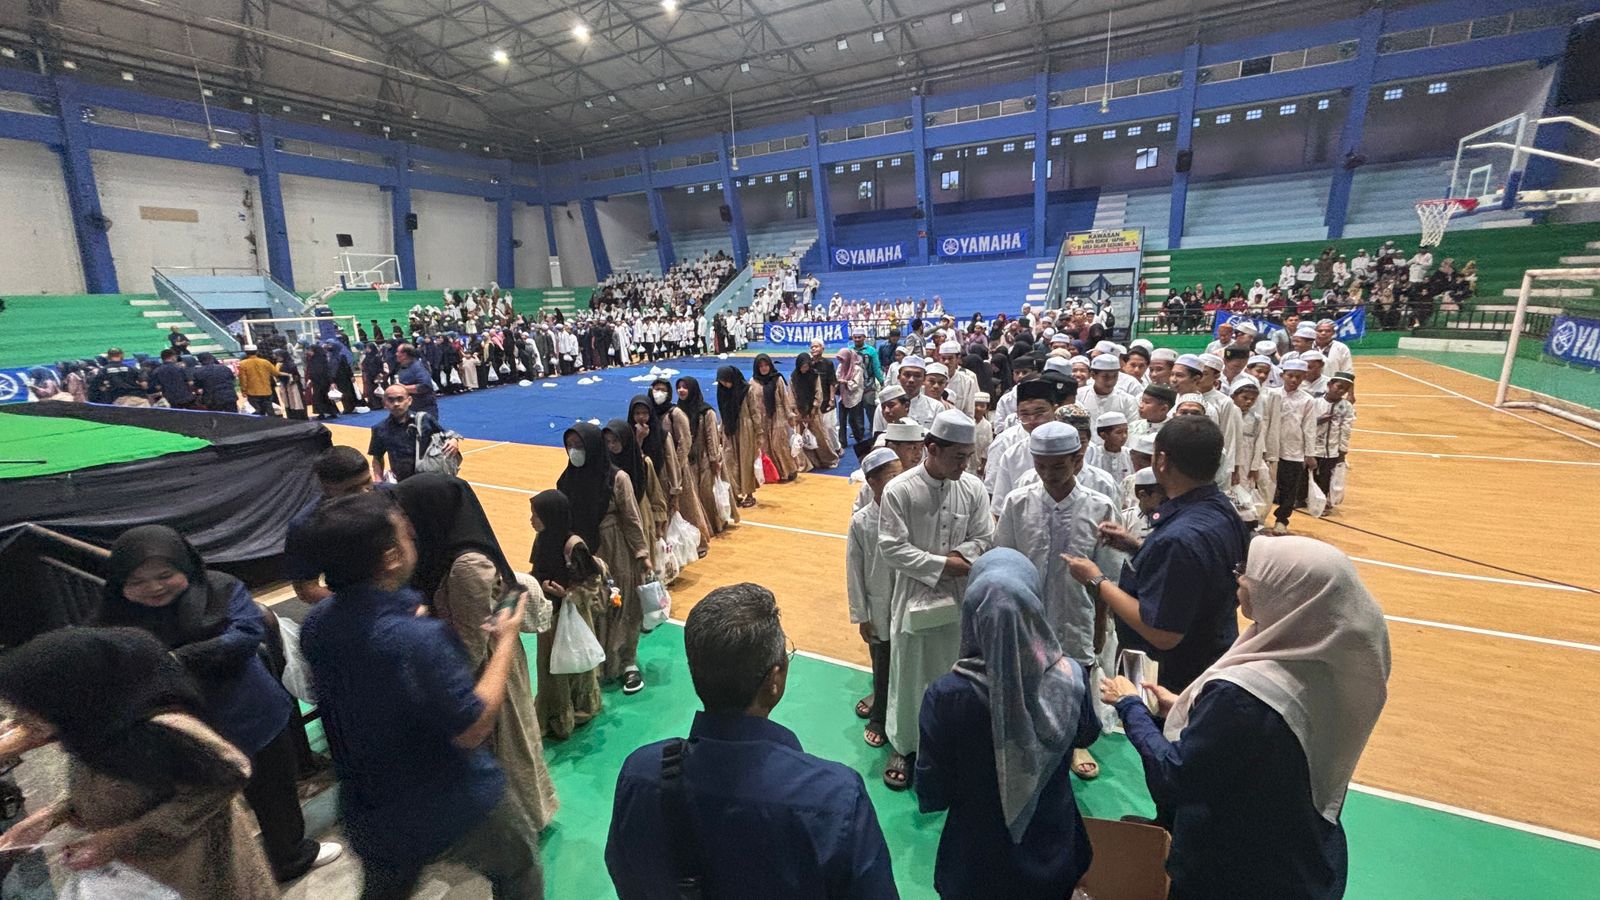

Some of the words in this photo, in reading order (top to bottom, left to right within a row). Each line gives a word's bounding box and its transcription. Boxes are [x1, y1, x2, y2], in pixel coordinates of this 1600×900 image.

[960, 232, 1022, 254] YAMAHA
[850, 244, 902, 265] YAMAHA
[785, 324, 843, 342] YAMAHA
